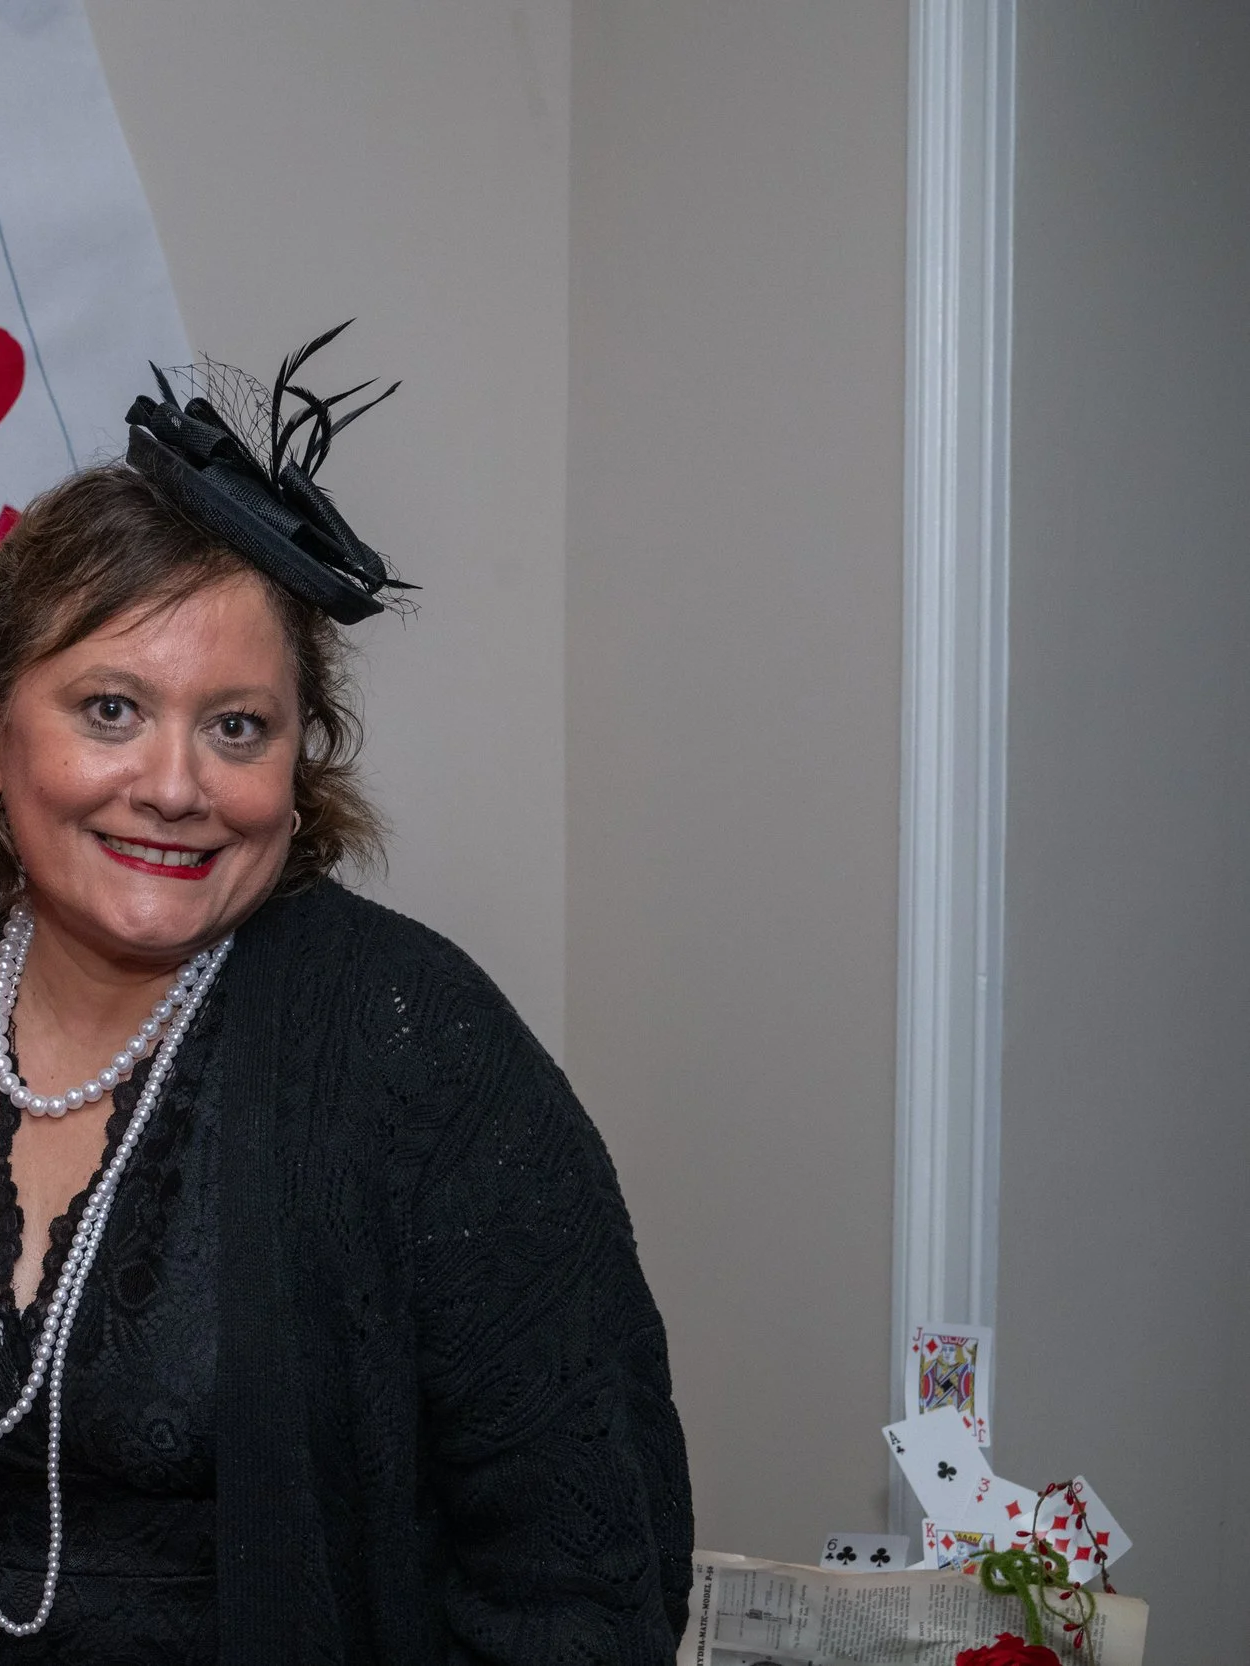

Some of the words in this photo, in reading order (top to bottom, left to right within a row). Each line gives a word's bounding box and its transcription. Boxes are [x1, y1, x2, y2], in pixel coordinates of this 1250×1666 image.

[913, 1327, 923, 1341] J
[889, 1430, 901, 1445] A
[978, 1477, 991, 1493] 3
[925, 1522, 936, 1538] K
[827, 1538, 839, 1551] 6
